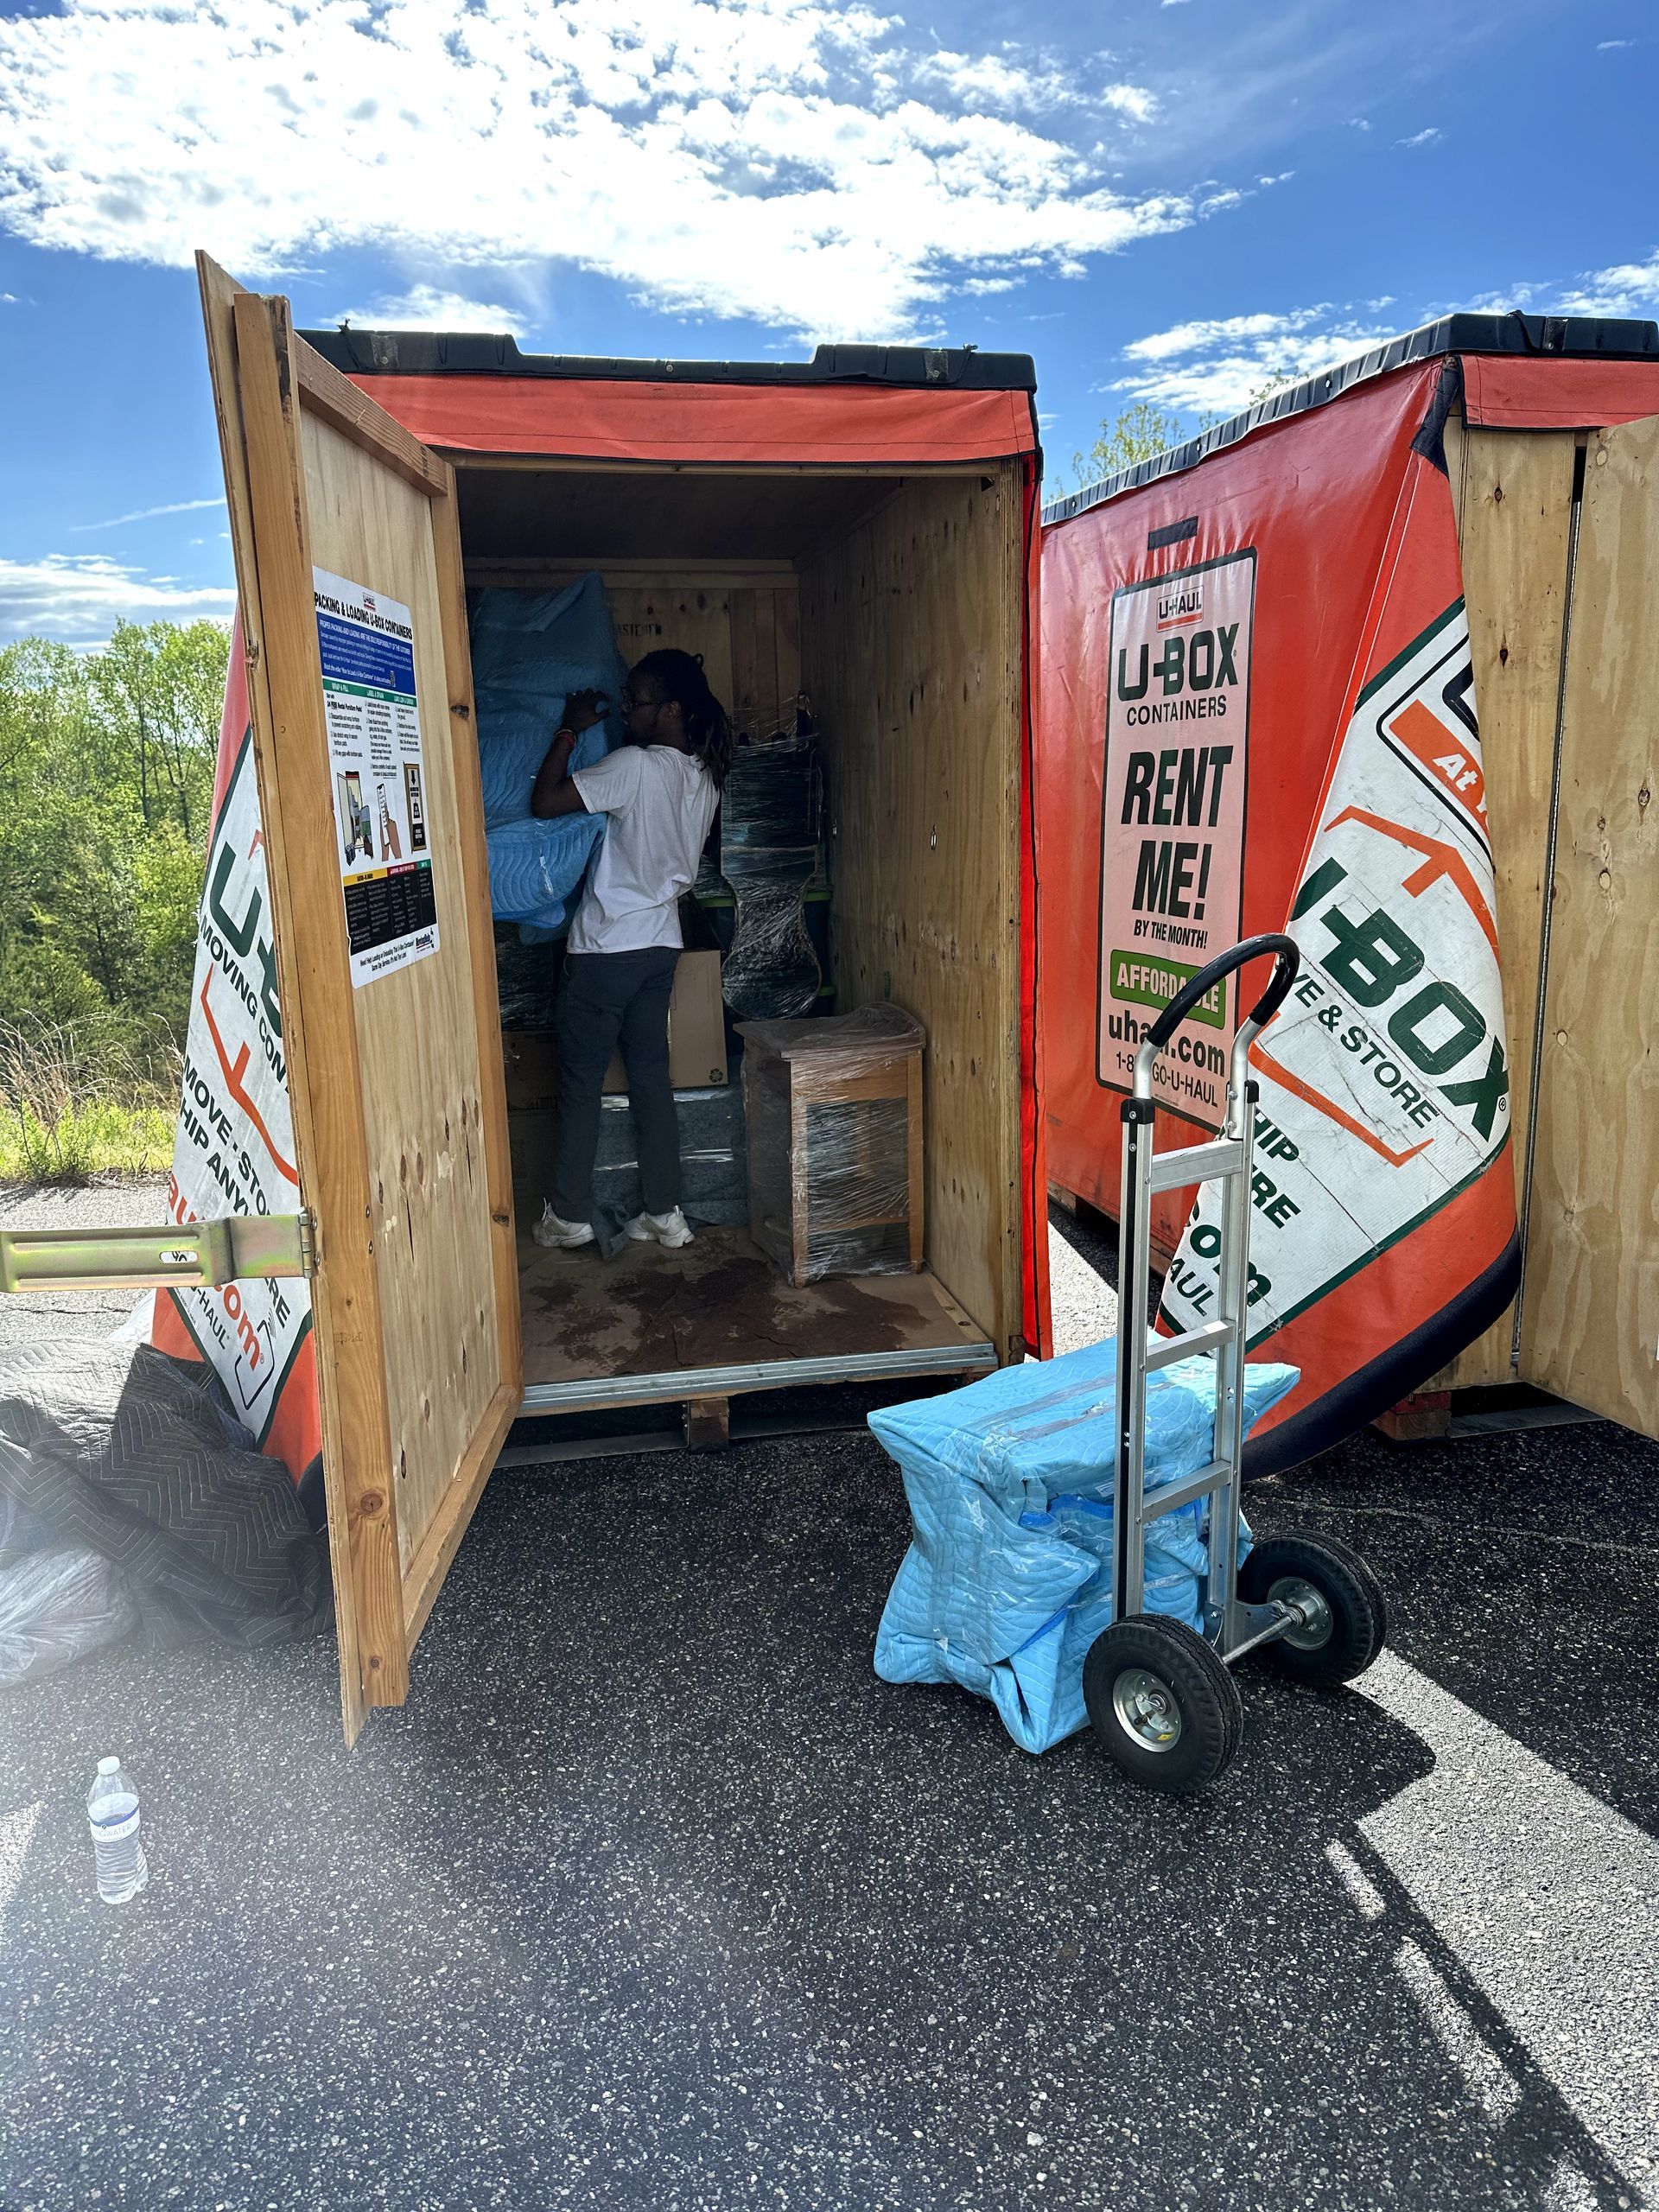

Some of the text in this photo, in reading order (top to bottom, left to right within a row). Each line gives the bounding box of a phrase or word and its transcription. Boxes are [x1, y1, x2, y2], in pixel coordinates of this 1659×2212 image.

[315, 592, 341, 614] PACKING
[346, 604, 370, 625] LOADING
[370, 612, 385, 632] U-BOX
[385, 619, 413, 640] CONTAINERS
[1159, 591, 1202, 620] U-HAUL
[1127, 695, 1227, 726] CONTAINERS
[1121, 745, 1234, 828] RENT
[1433, 753, 1478, 792] At
[1132, 841, 1212, 920] ME!
[1134, 919, 1208, 950] BY THE MONTH!
[200, 915, 289, 1094] MOVING CON
[1116, 963, 1219, 1014] AFFORDALE
[1318, 1005, 1342, 1033] &
[1340, 1026, 1440, 1129] STORE
[184, 1054, 232, 1146] MOVE
